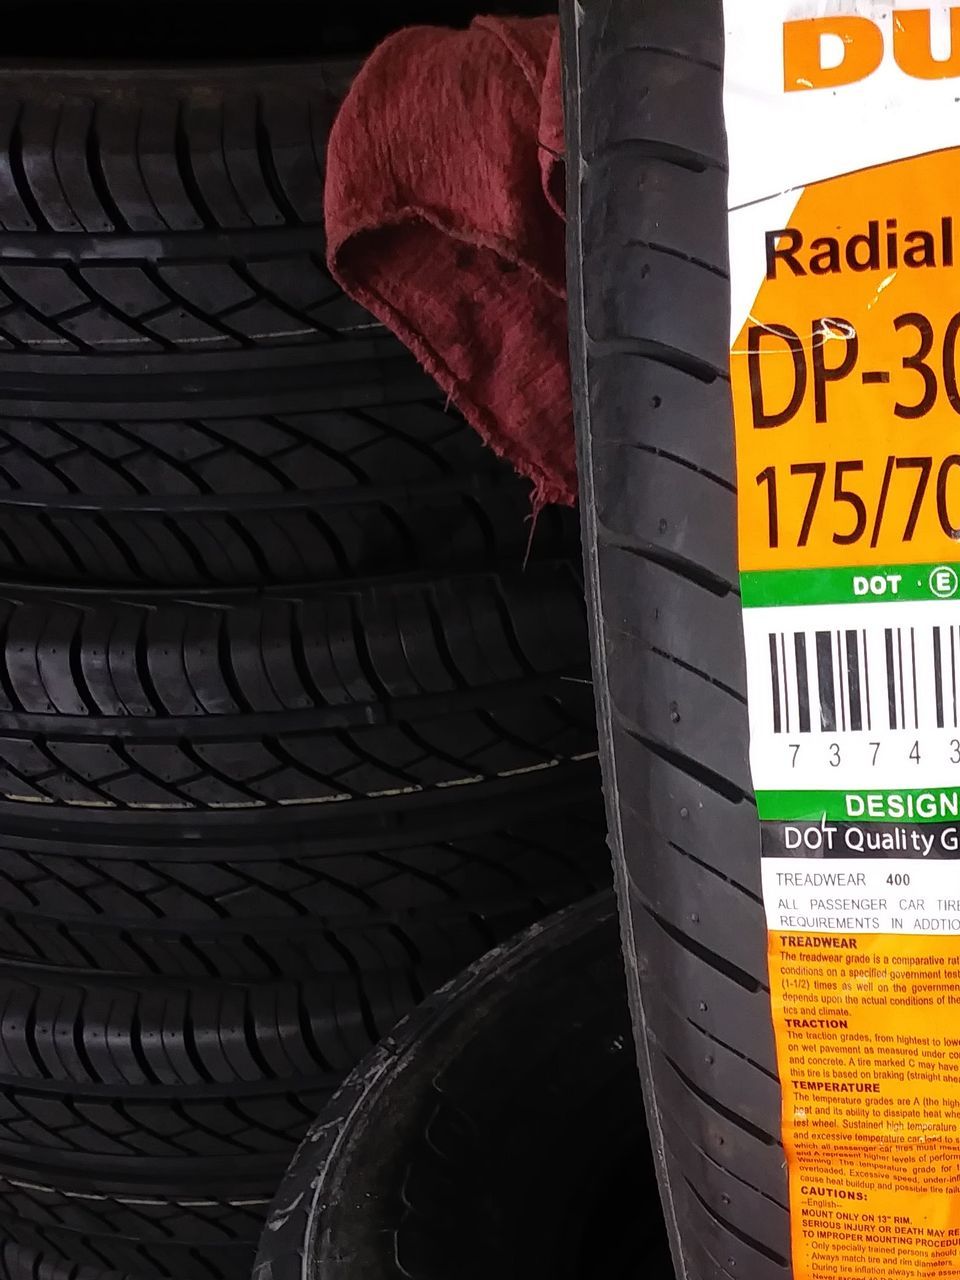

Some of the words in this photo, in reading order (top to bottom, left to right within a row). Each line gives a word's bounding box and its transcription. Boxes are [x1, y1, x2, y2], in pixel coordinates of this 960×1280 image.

[765, 217, 953, 280] Radial
[853, 575, 901, 596] DOT
[784, 826, 839, 850] DOT
[844, 826, 934, 857] Quality
[776, 872, 866, 889] TREADWEAR
[886, 873, 911, 887] 400
[777, 898, 801, 912] ALL
[809, 898, 888, 912] PASSENGER
[899, 898, 925, 912] CAR
[780, 915, 880, 931] REQUIREMENTS
[891, 917, 903, 930] IN
[781, 936, 856, 949] TREADWEAR
[781, 951, 796, 961] The
[799, 952, 842, 963] treadwear
[845, 953, 870, 966] grade
[891, 955, 944, 967] comparative
[780, 966, 823, 977] conditions
[826, 969, 837, 977] on
[848, 968, 886, 980] specified
[889, 969, 940, 981] government
[944, 969, 960, 979] test
[813, 980, 837, 990] times
[841, 982, 852, 990] as
[856, 981, 873, 991] well
[877, 983, 888, 992] on
[892, 982, 906, 992] the
[786, 1019, 847, 1029] TRACTION
[787, 1030, 803, 1040] The
[805, 1030, 837, 1041] traction
[840, 1031, 871, 1044] grades,
[874, 1032, 894, 1043] from
[932, 1036, 940, 1046] to
[793, 1080, 879, 1093] TEMPERATURE
[800, 1186, 868, 1201] CAUTIONS:
[801, 1208, 832, 1219] MOUNT
[835, 1210, 858, 1222] ONLY
[861, 1213, 874, 1223] ON
[893, 1214, 912, 1224] RIM.
[802, 1218, 841, 1229] SERIOUS
[843, 1221, 875, 1232] INJURY
[878, 1224, 891, 1234] OR
[894, 1225, 923, 1236] DEATH
[926, 1227, 945, 1237] MAY
[802, 1229, 814, 1239] TO
[816, 1230, 863, 1242] IMPROPER
[865, 1234, 912, 1245] MOUNTING
